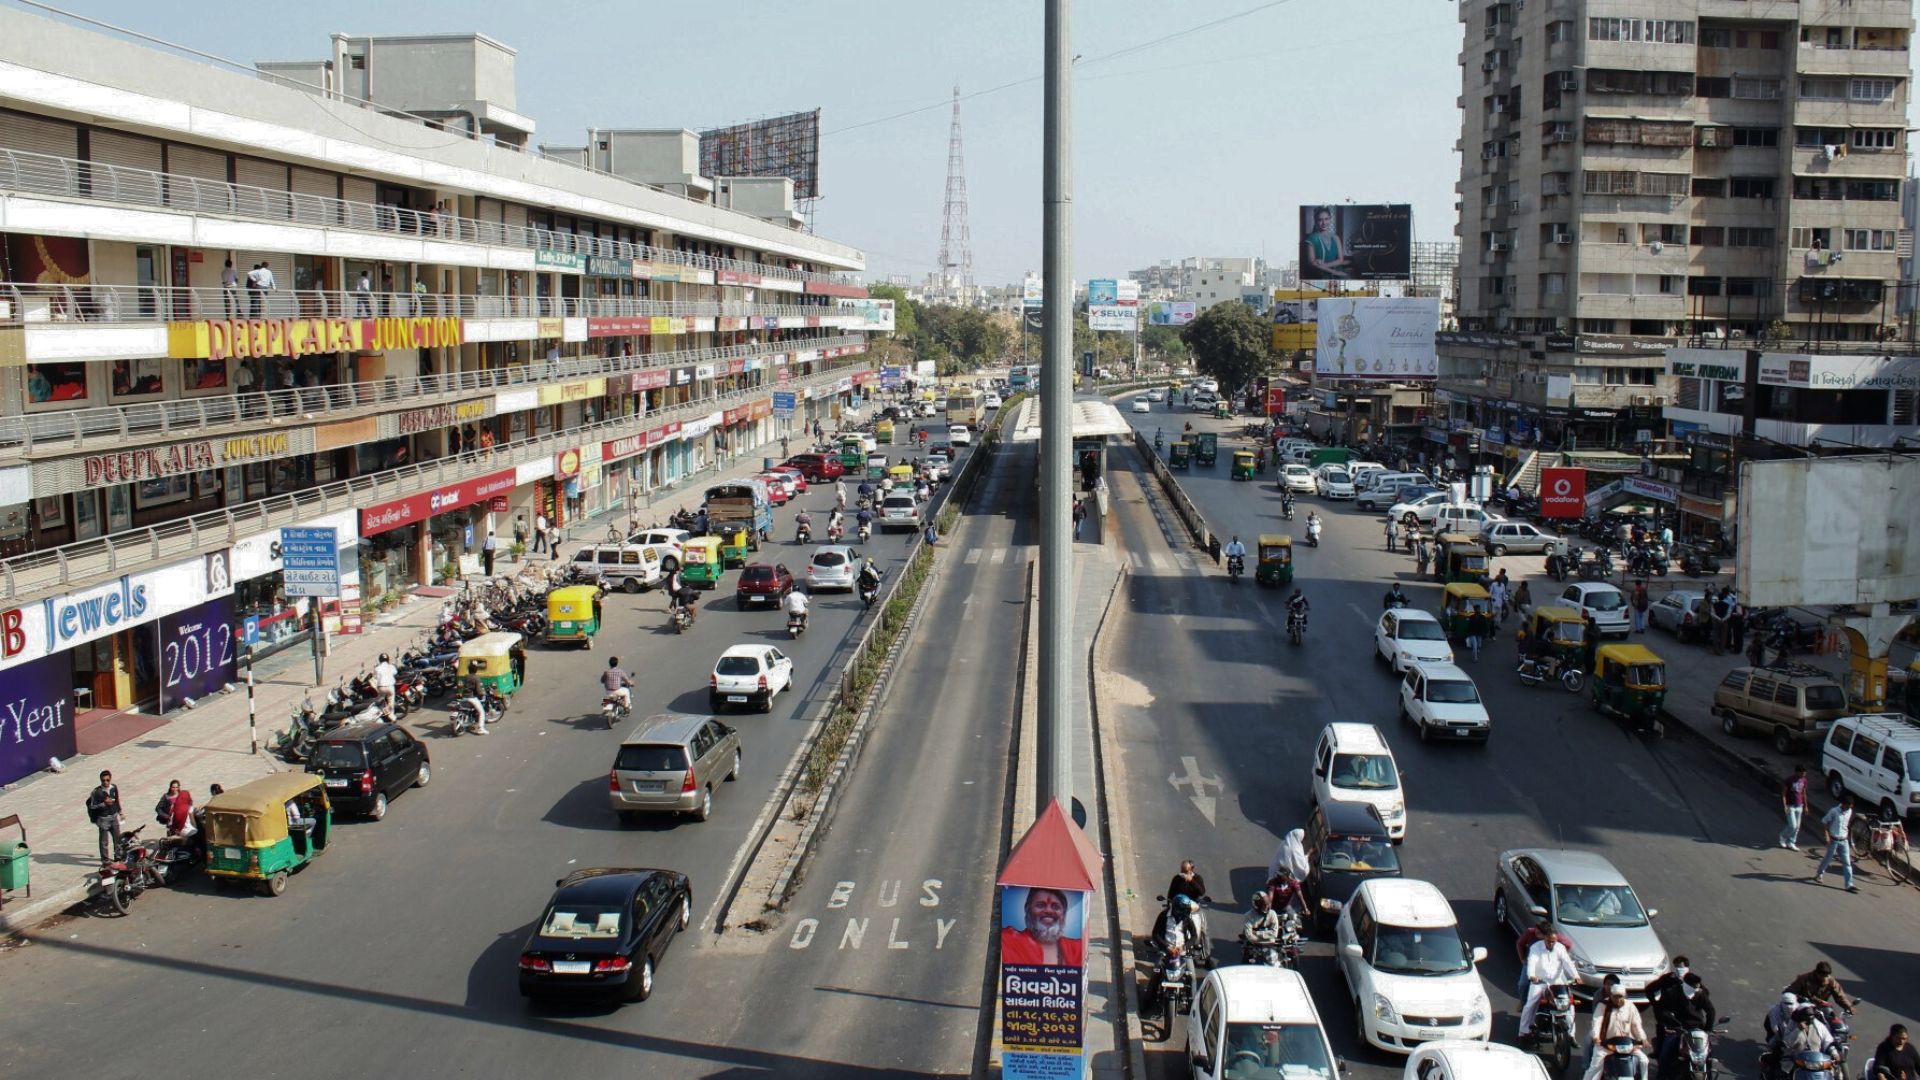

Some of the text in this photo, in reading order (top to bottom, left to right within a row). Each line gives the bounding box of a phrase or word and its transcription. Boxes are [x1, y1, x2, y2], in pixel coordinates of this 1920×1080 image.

[1100, 309, 1135, 318] SELVEL
[208, 316, 462, 361] DEEPKALA JUNCTION
[1591, 341, 1625, 350] BlackBerry
[85, 432, 289, 484] DEEPKALA JUNCTION
[440, 489, 461, 506] kotak
[1545, 495, 1580, 504] vodafone
[43, 574, 148, 654] Jewels
[178, 621, 203, 636] Welcome
[247, 621, 256, 636] P
[166, 623, 233, 688] 2012
[7, 698, 66, 744] Year
[826, 878, 943, 908] BUS
[789, 917, 957, 950] ONLY
[1005, 975, 1077, 996] શિવયોગ
[1005, 996, 1076, 1010] સાધના શિબિર
[1042, 1023, 1076, 1034] ૨૦૧૨
